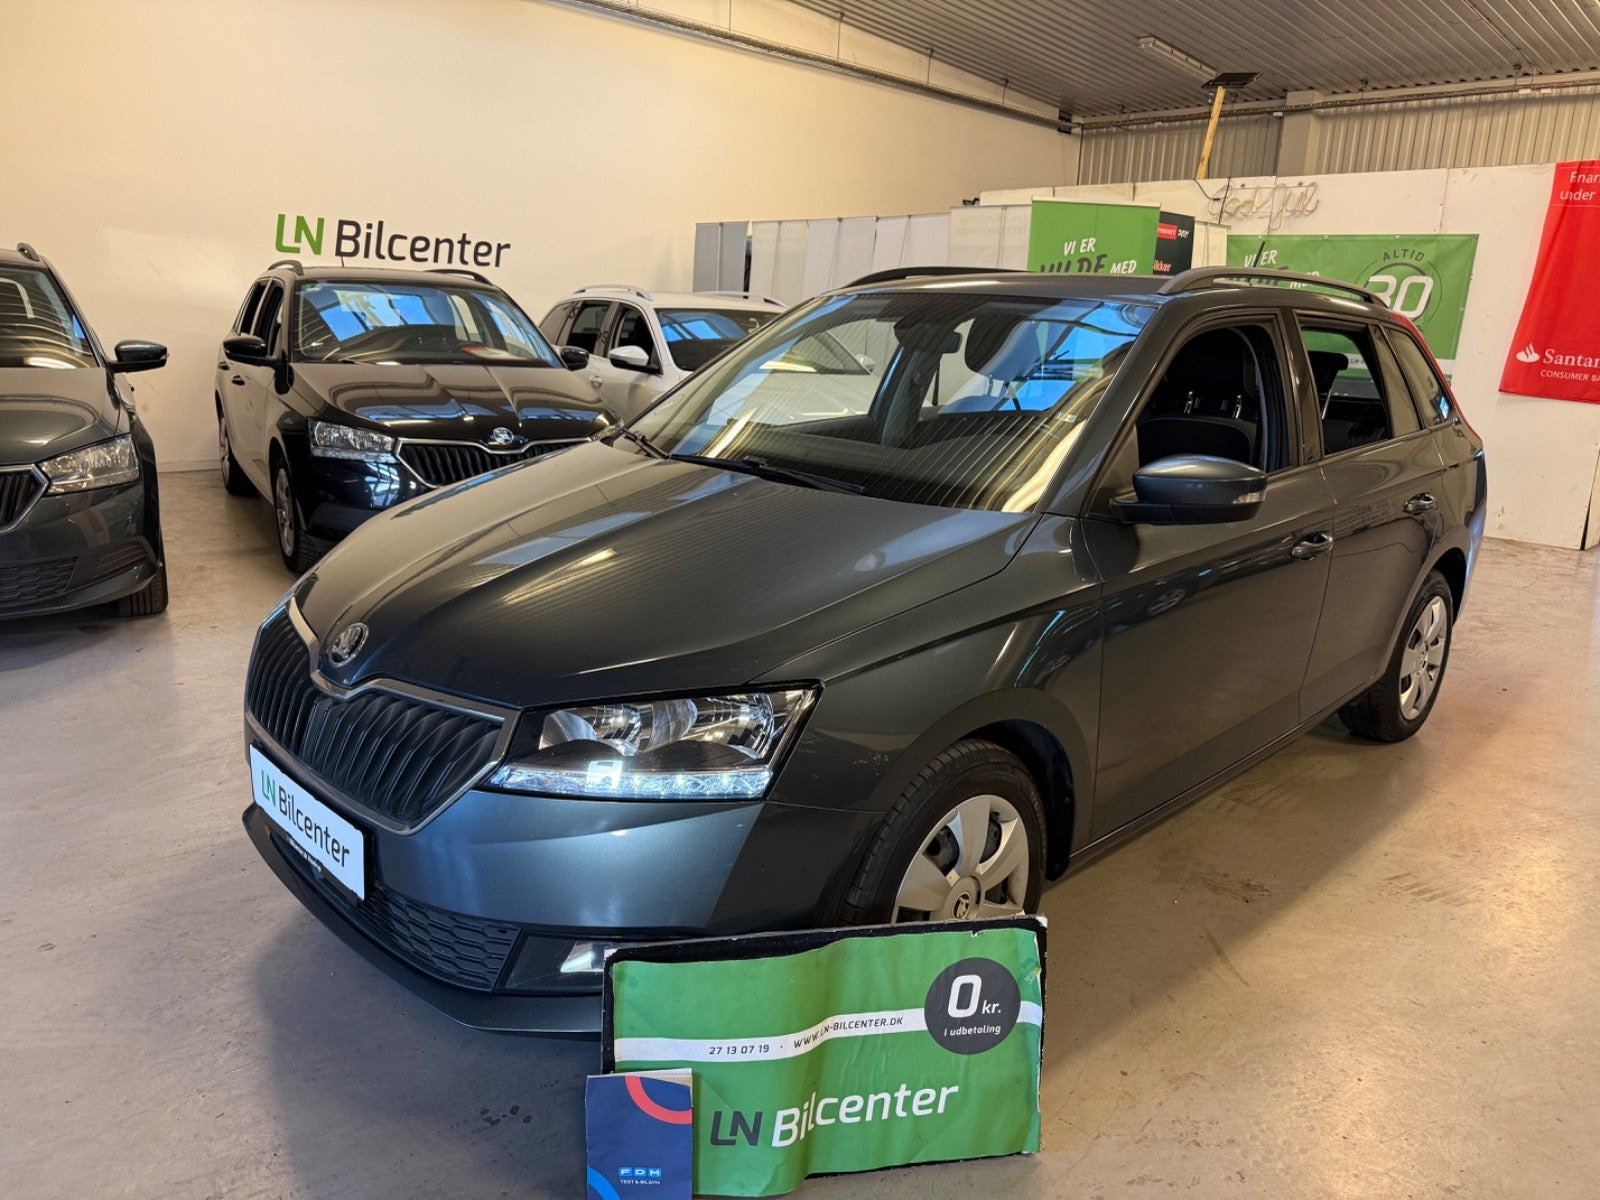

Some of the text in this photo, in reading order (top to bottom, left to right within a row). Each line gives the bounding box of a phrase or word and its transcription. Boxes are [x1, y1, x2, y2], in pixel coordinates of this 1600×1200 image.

[275, 213, 512, 268] LN Bilcenter
[1064, 237, 1097, 256] VI ER
[1260, 249, 1278, 266] ER
[1383, 248, 1425, 262] ALTID
[1110, 259, 1137, 274] MED
[1368, 274, 1434, 318] 30
[1540, 369, 1589, 381] CONSUMER
[261, 769, 276, 807] LN
[278, 784, 350, 868] Bilcenter
[947, 974, 1001, 1018] 0 kr.
[950, 1025, 1001, 1036] udbetaling
[709, 1046, 722, 1055] 27
[727, 1046, 737, 1055] 13
[741, 1045, 754, 1054] 07
[759, 1044, 769, 1053] 19
[709, 1083, 959, 1148] LN Bilcenter
[620, 1168, 660, 1176] FDM
